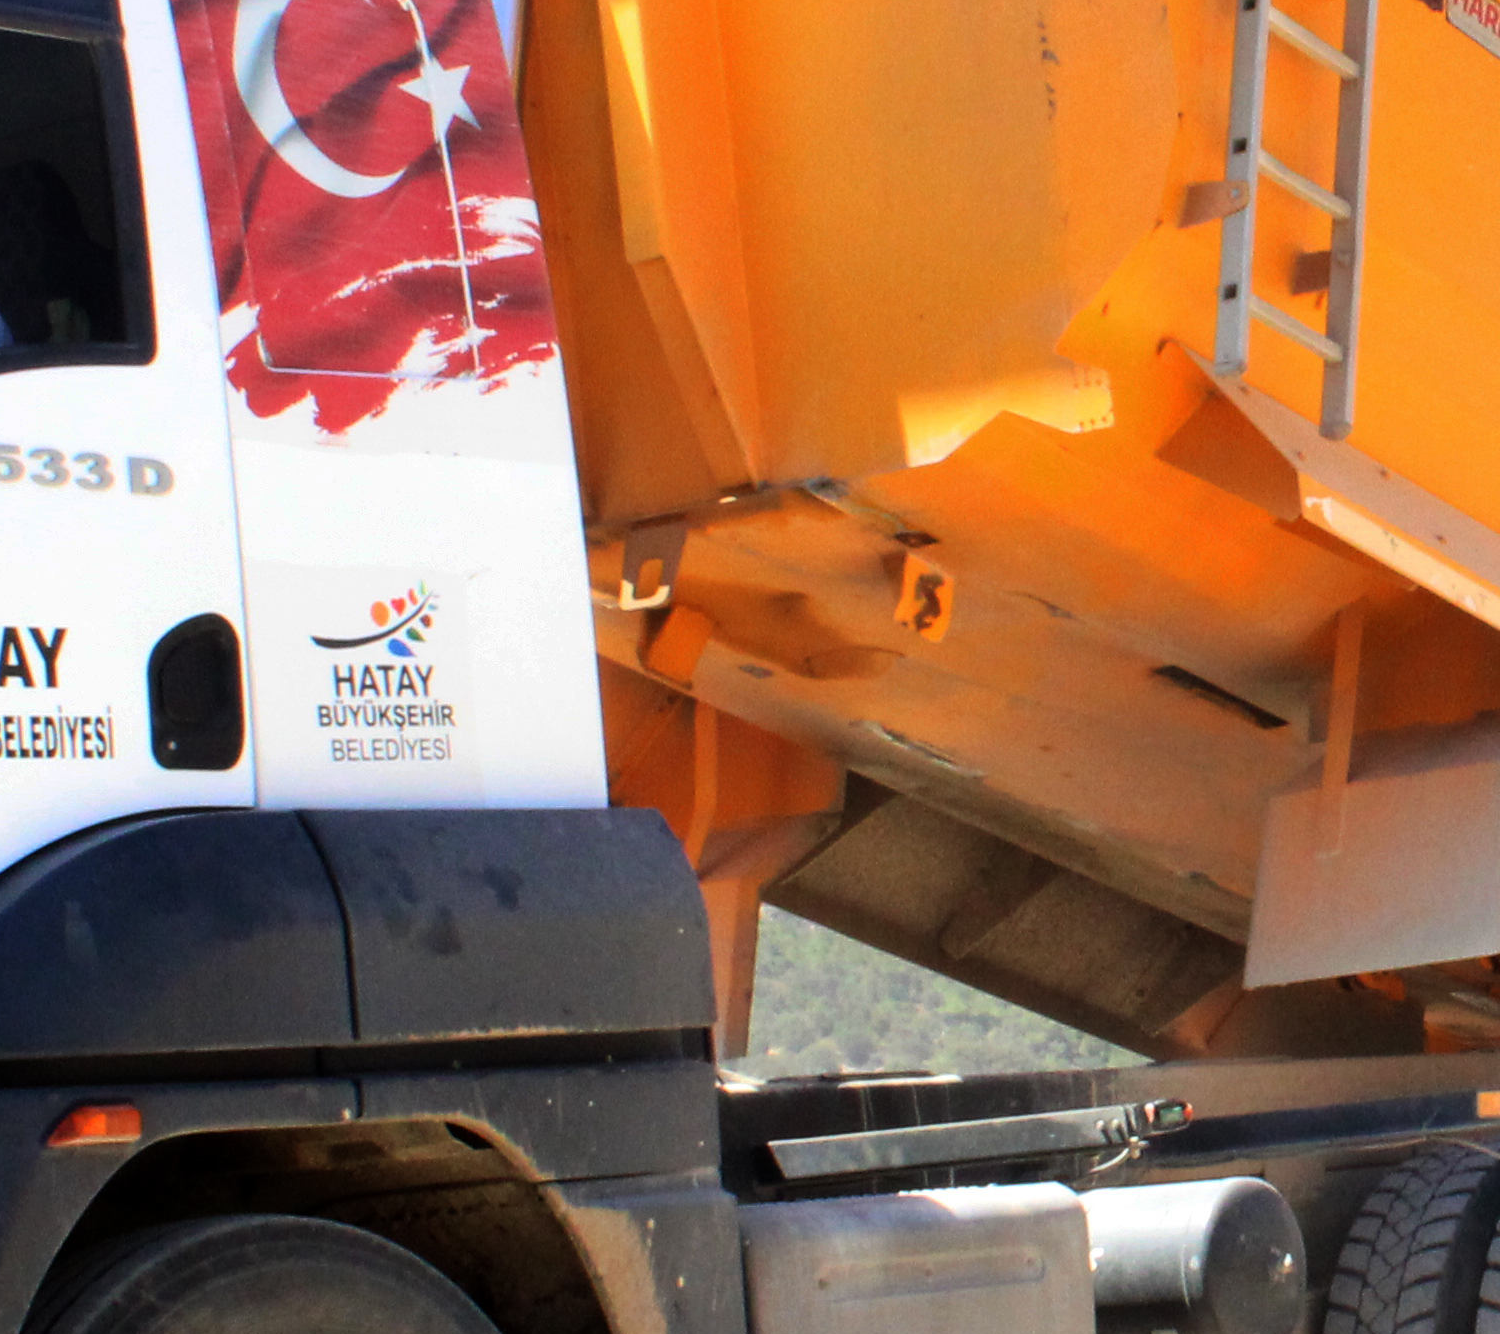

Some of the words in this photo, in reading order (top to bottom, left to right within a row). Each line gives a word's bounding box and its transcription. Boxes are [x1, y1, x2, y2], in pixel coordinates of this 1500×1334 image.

[127, 455, 176, 497] D
[333, 663, 435, 698] HATAY
[318, 699, 458, 732] BÜYÜKŞEHİR
[331, 734, 453, 762] BELEDİYESİ
